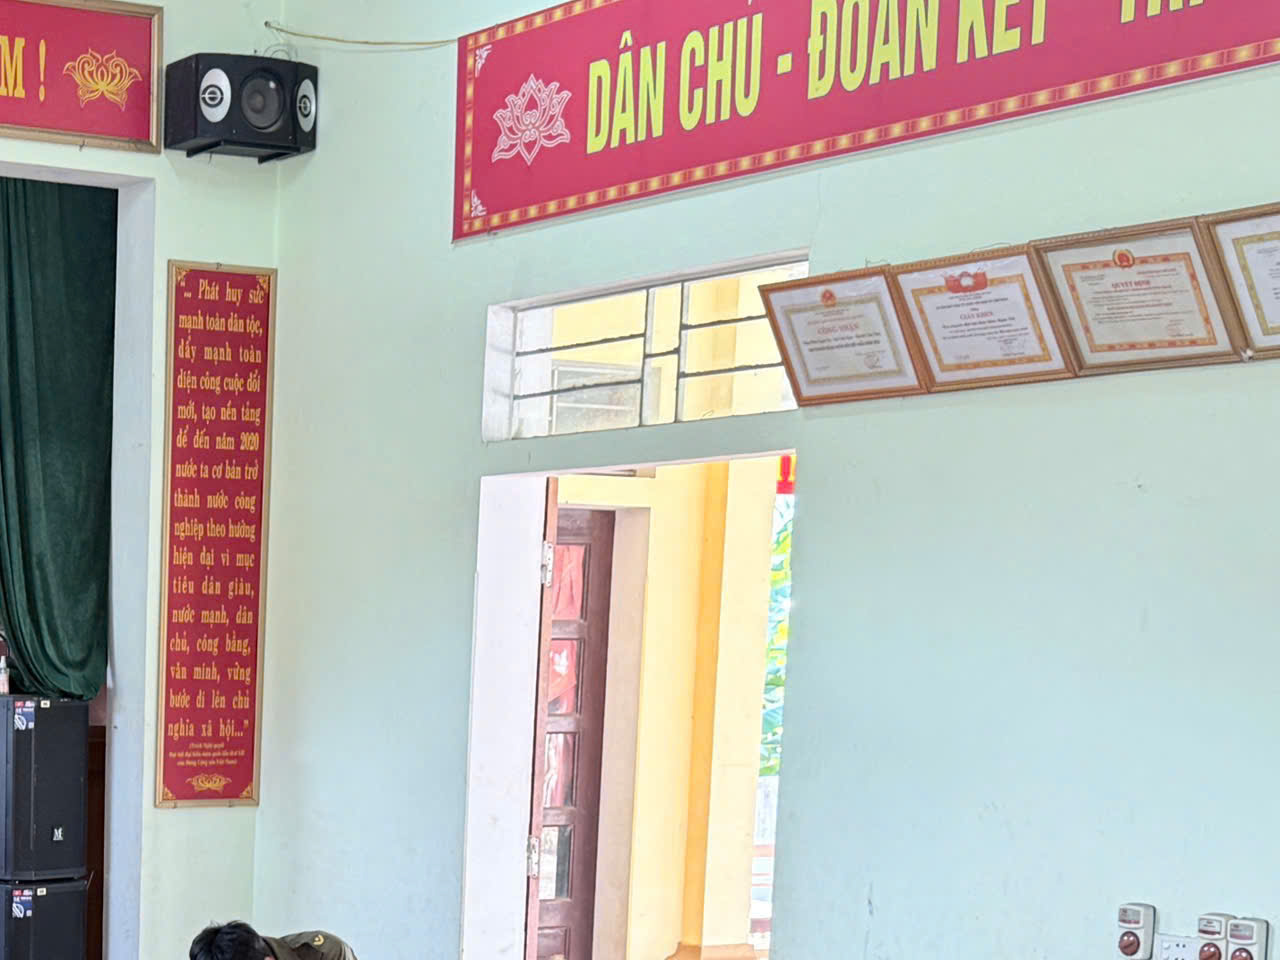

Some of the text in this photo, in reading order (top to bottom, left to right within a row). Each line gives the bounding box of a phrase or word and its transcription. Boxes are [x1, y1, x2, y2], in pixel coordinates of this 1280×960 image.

[586, 30, 666, 154] DÂN
[198, 279, 220, 301] Phát
[225, 281, 243, 306] huy
[179, 310, 204, 333] mạnh
[206, 312, 226, 331] toàn
[228, 312, 245, 332] dân
[204, 342, 232, 364] mạnh
[239, 345, 262, 363] toàn
[200, 371, 221, 394] công
[223, 373, 244, 396] cuộc
[202, 402, 216, 425] tạo
[240, 432, 259, 451] 2020
[176, 458, 197, 478] nước
[200, 462, 209, 479] ta
[212, 462, 223, 479] cơ
[174, 488, 256, 513] thành nước công
[174, 517, 204, 541] nghiệp
[207, 518, 226, 537] theo
[173, 545, 193, 569] hiện
[236, 553, 255, 571] mục
[173, 576, 194, 594] tiêu
[201, 576, 221, 595] dân
[172, 604, 195, 623] nước
[236, 605, 253, 624] dân
[196, 634, 219, 656] công
[193, 661, 220, 683] minh,
[211, 689, 226, 708] lên
